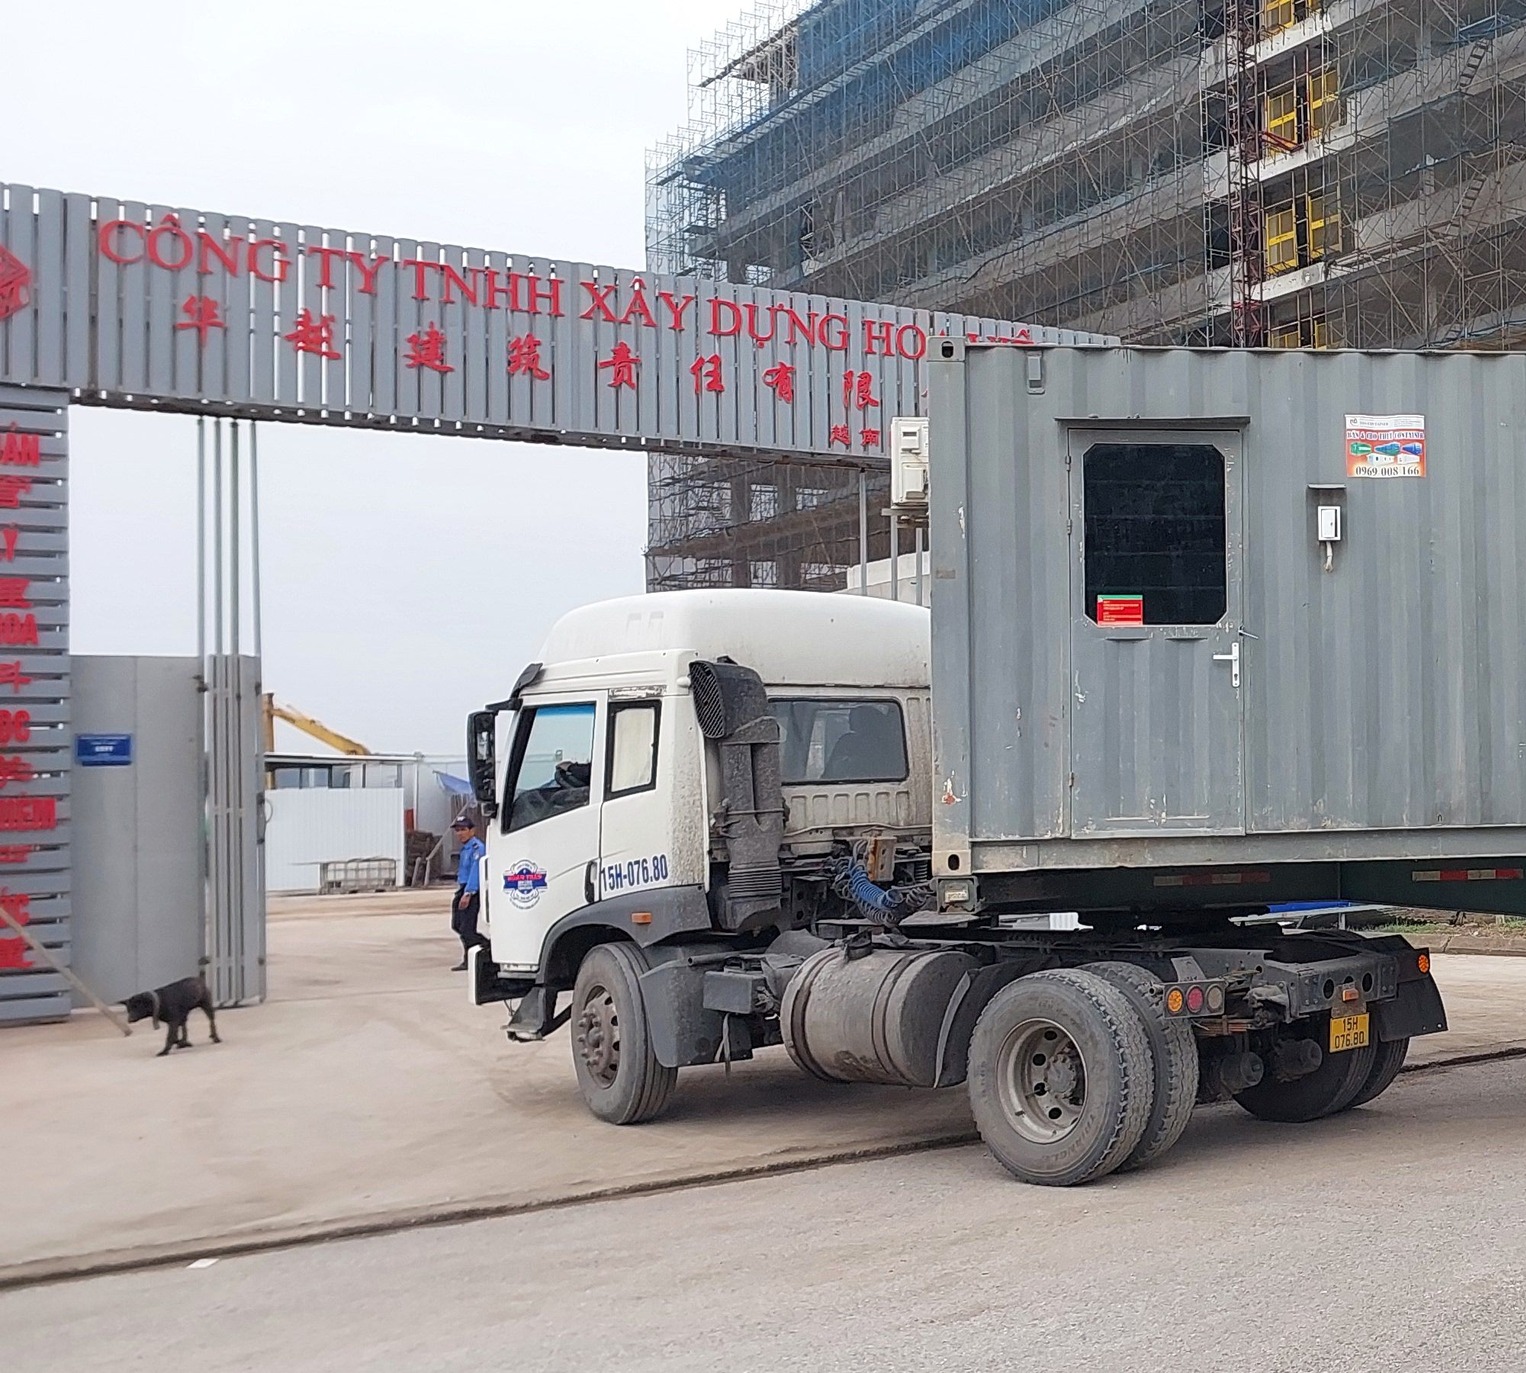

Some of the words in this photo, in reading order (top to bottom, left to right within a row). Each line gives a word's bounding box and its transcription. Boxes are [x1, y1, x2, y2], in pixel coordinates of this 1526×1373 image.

[101, 213, 292, 283] CÔNG
[308, 244, 391, 295] TY
[403, 257, 565, 318] TNHH
[579, 278, 695, 332] XÂY
[706, 298, 849, 352] DỰNG
[864, 318, 947, 360] HO
[1355, 466, 1378, 477] 0969
[1380, 466, 1399, 476] 008
[1402, 466, 1420, 475] 166
[601, 854, 669, 892] 15H-076.80
[1342, 1016, 1359, 1032] 15H
[1334, 1031, 1365, 1049] 076.80
